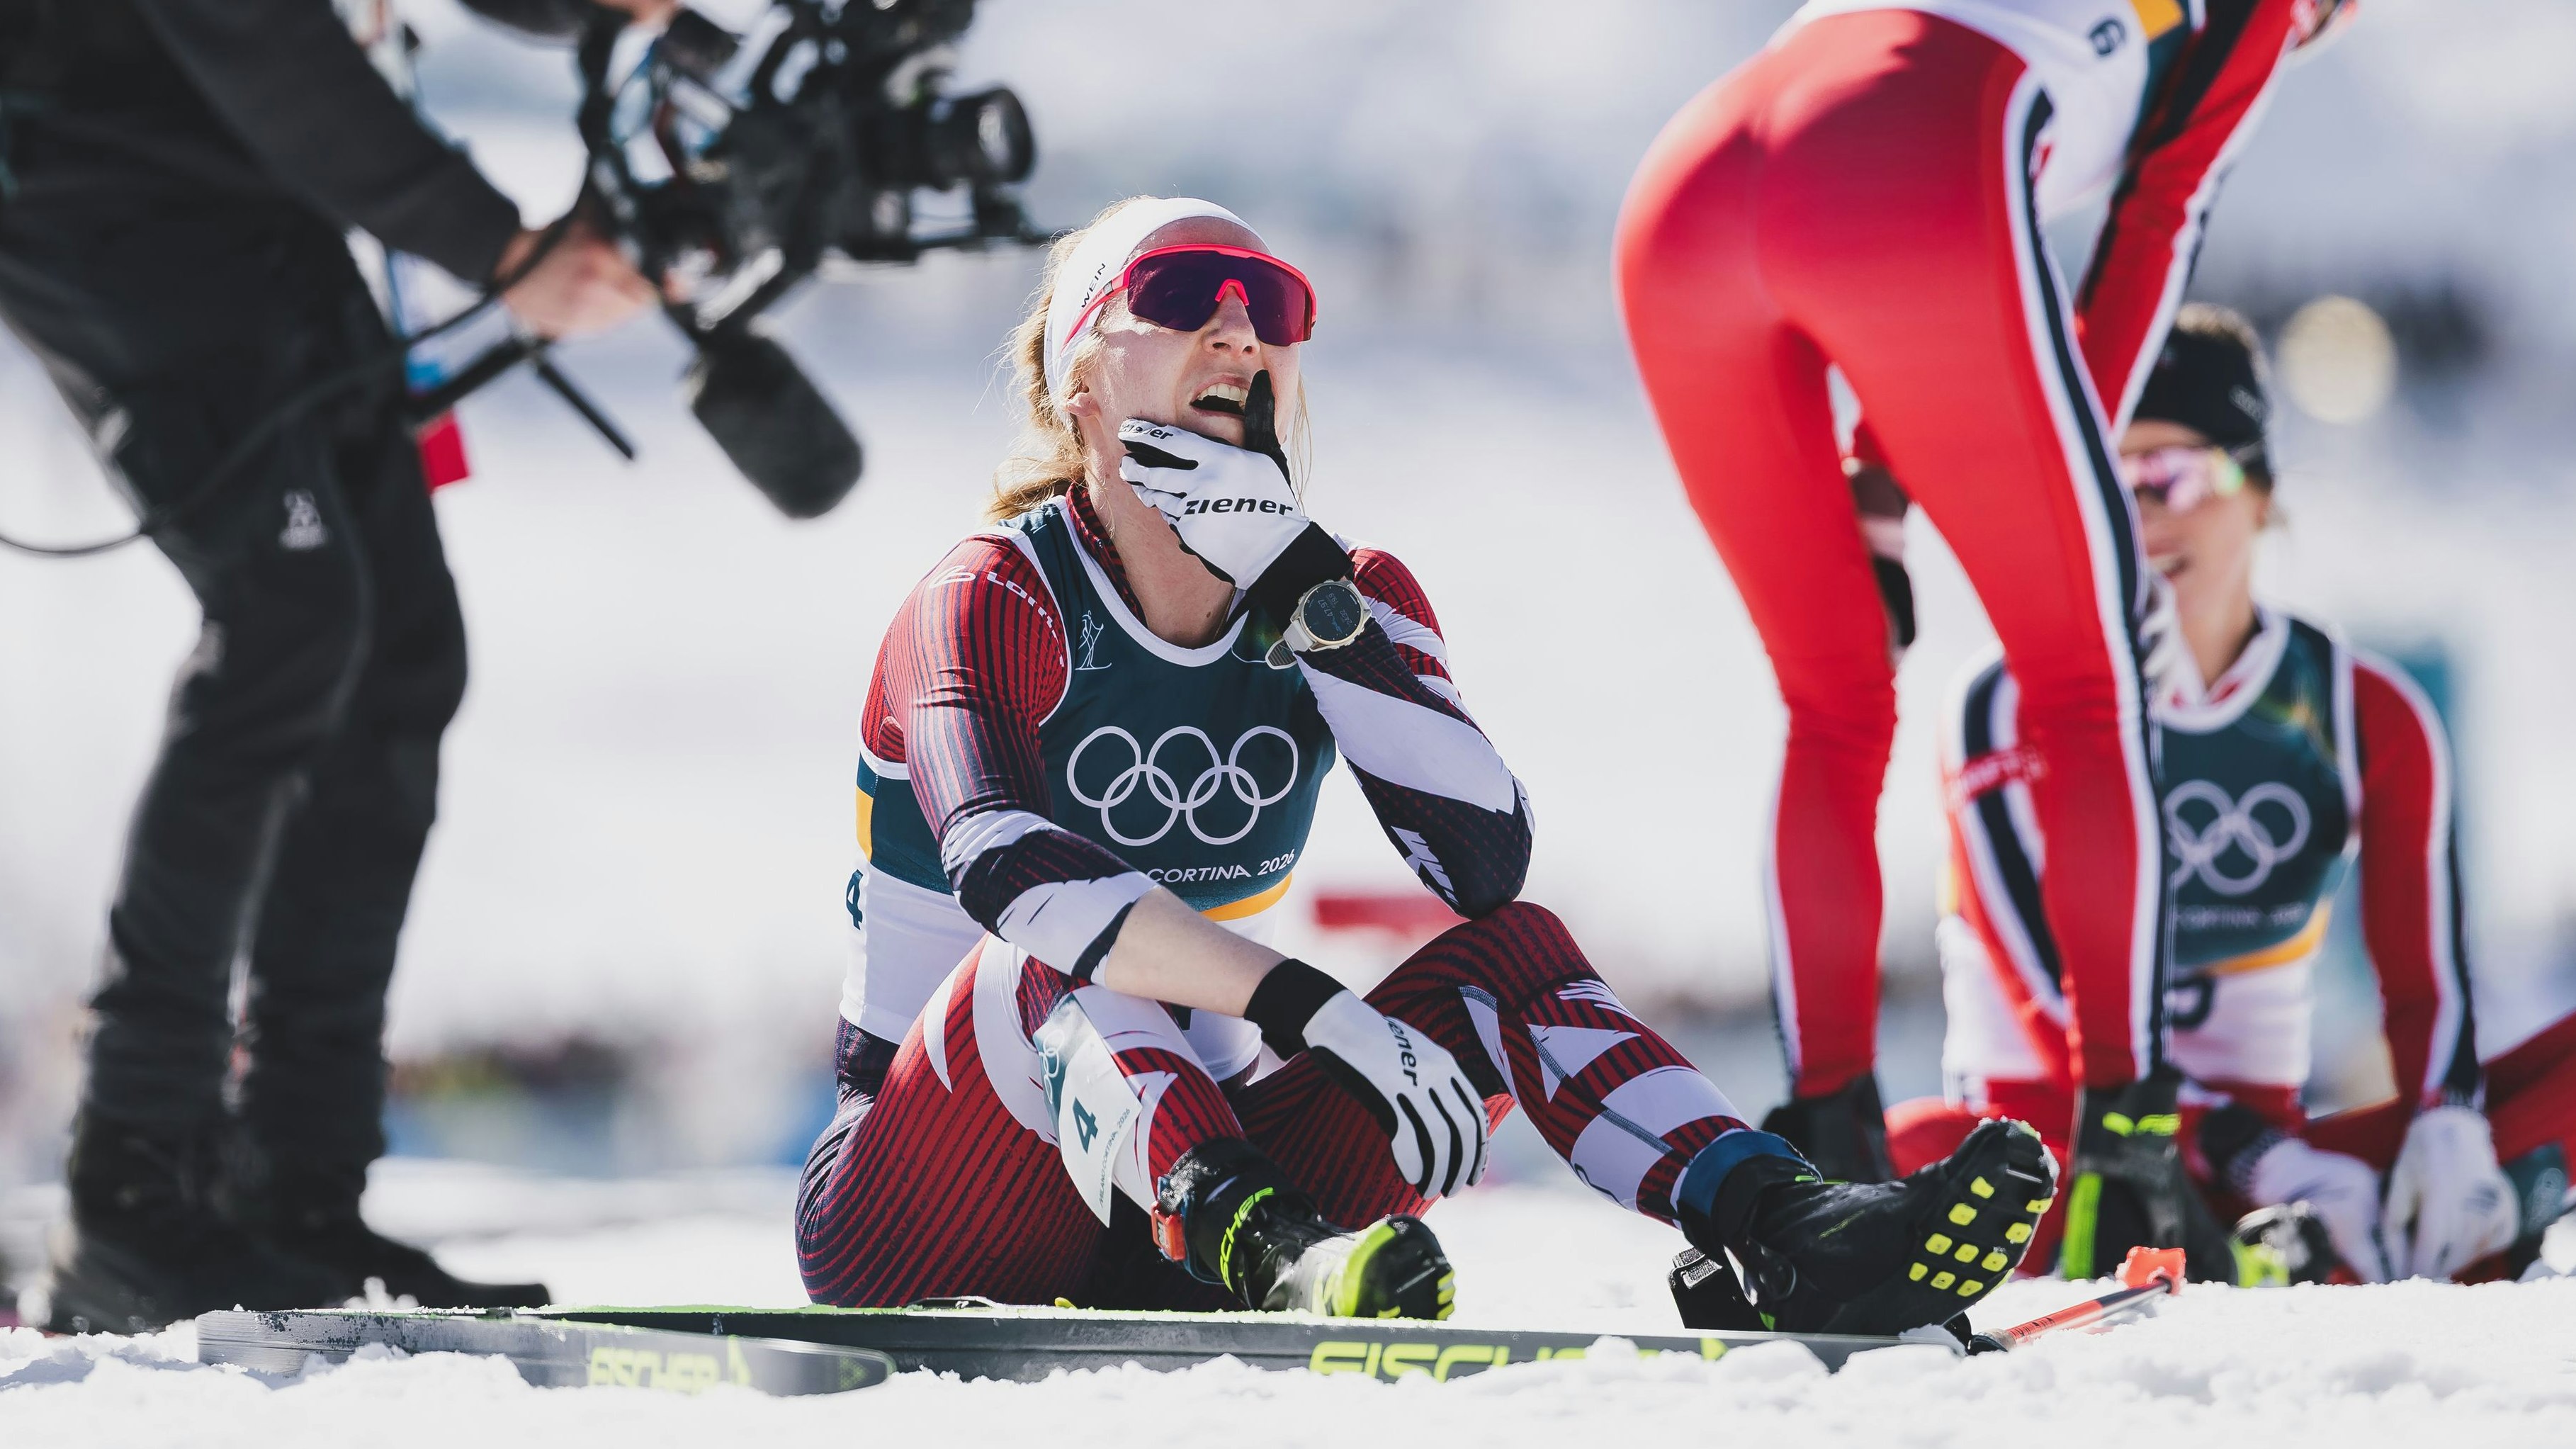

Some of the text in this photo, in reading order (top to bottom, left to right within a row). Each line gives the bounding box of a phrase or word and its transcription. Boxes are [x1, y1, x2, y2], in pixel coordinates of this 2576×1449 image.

[1183, 497, 1294, 516] ziener
[1146, 849, 1296, 884] CORTINA 2026
[1072, 1095, 1099, 1155] 4
[1117, 1107, 1131, 1129] 2026
